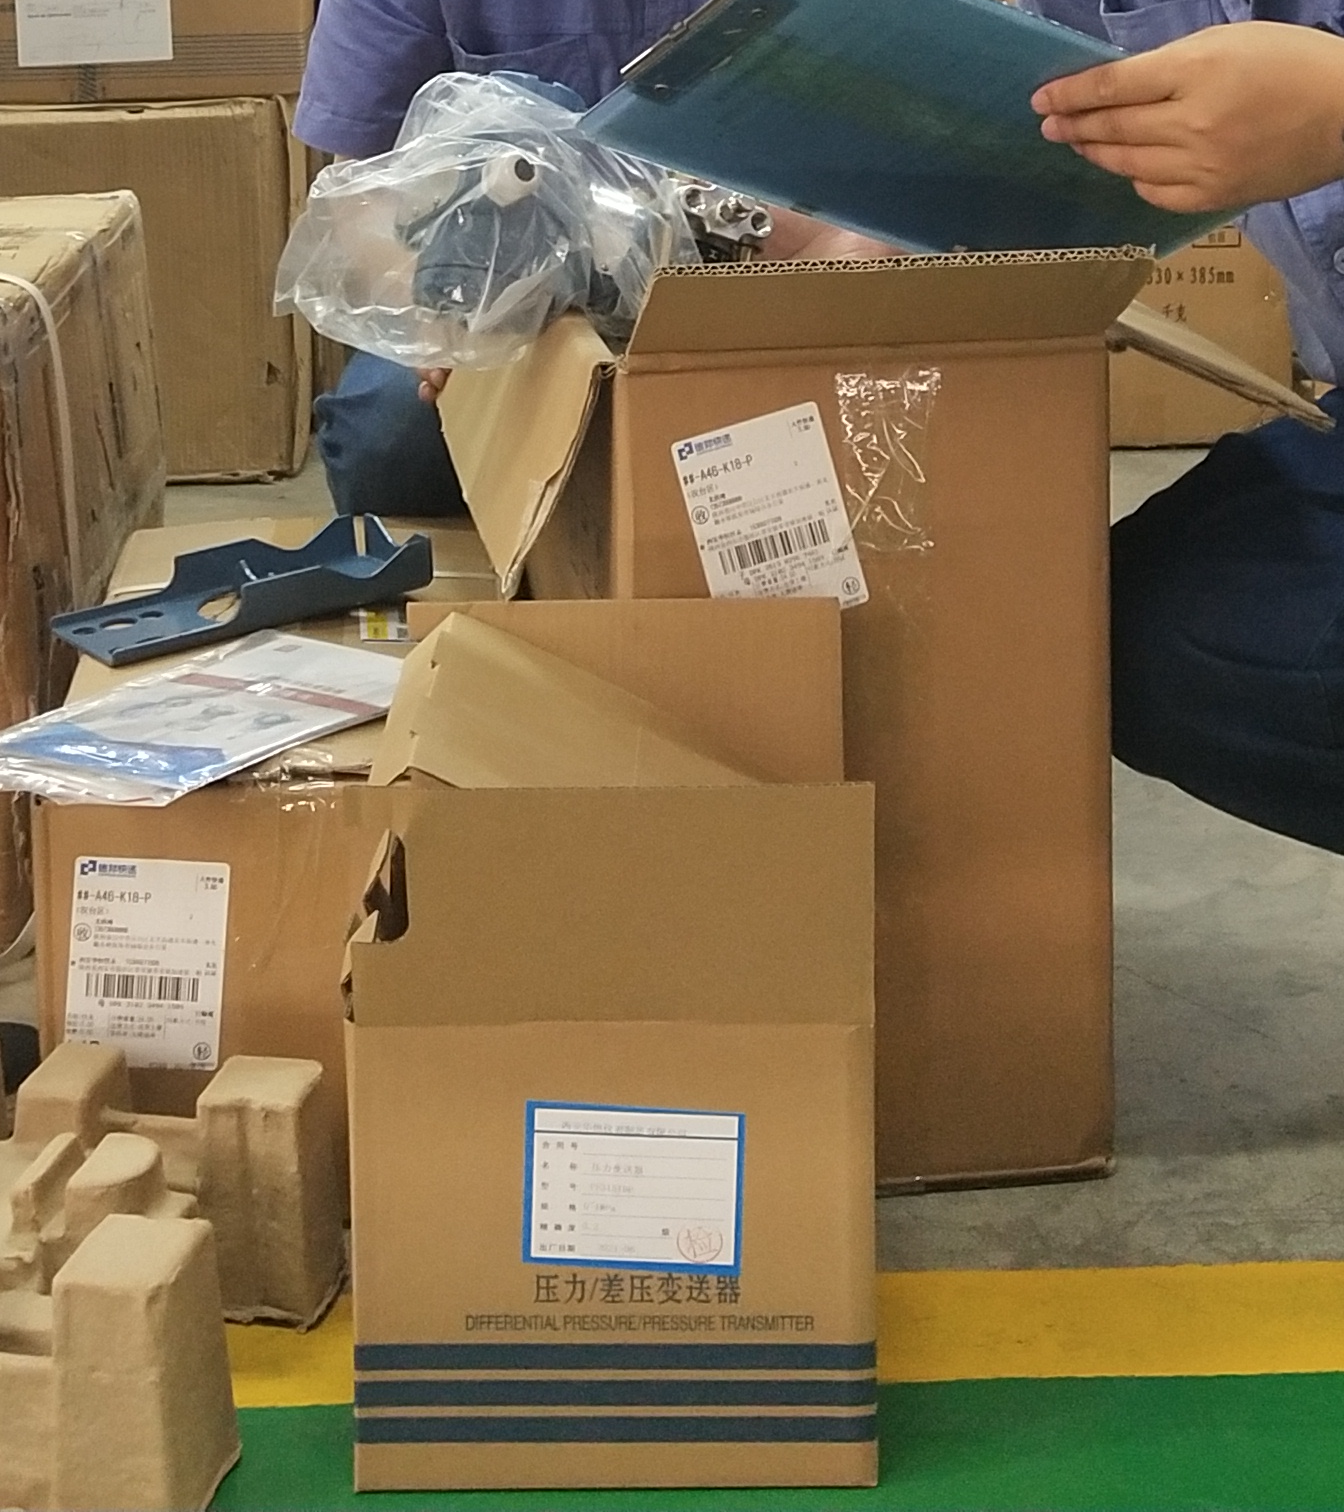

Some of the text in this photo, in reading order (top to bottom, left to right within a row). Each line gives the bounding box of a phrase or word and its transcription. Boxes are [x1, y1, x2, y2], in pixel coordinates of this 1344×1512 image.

[1190, 267, 1234, 285] 385mm
[533, 1274, 741, 1305] 压力/差压变送器
[465, 1314, 816, 1332] DIFFERENTIAL PRESSURE/PRESSURE TRANSMITTER
